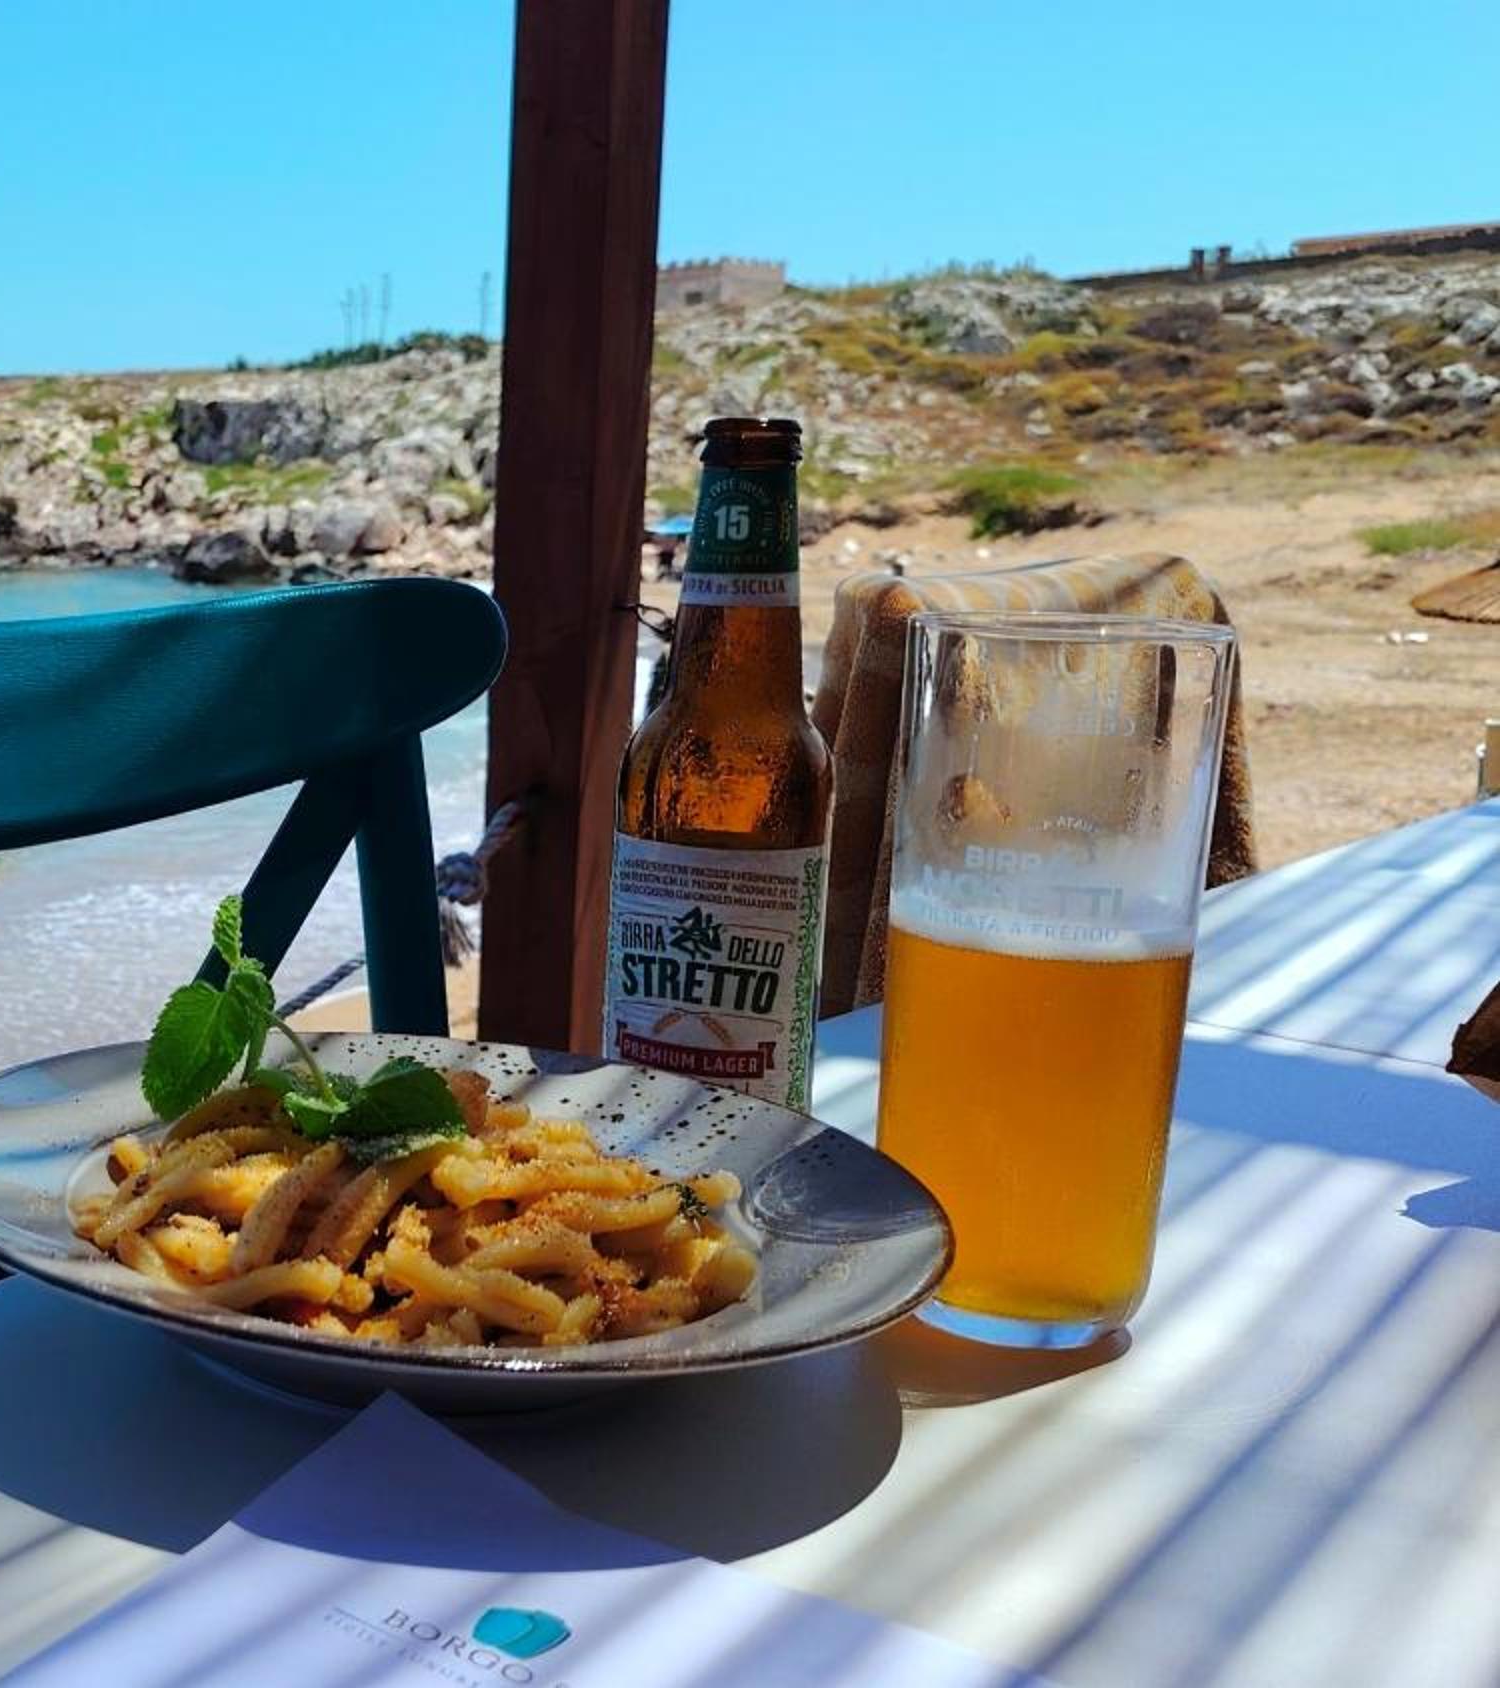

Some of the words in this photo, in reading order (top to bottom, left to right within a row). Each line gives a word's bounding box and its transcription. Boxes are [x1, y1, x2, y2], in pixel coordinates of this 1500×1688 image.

[713, 505, 750, 541] 15
[731, 577, 787, 595] SICILIA
[621, 920, 667, 951] BIRRA
[727, 935, 785, 969] DELLO
[621, 952, 781, 1015] STRETTO
[622, 1040, 695, 1070] PREMIUM
[703, 1057, 758, 1073] LAGER
[384, 1608, 534, 1685] BORGO
